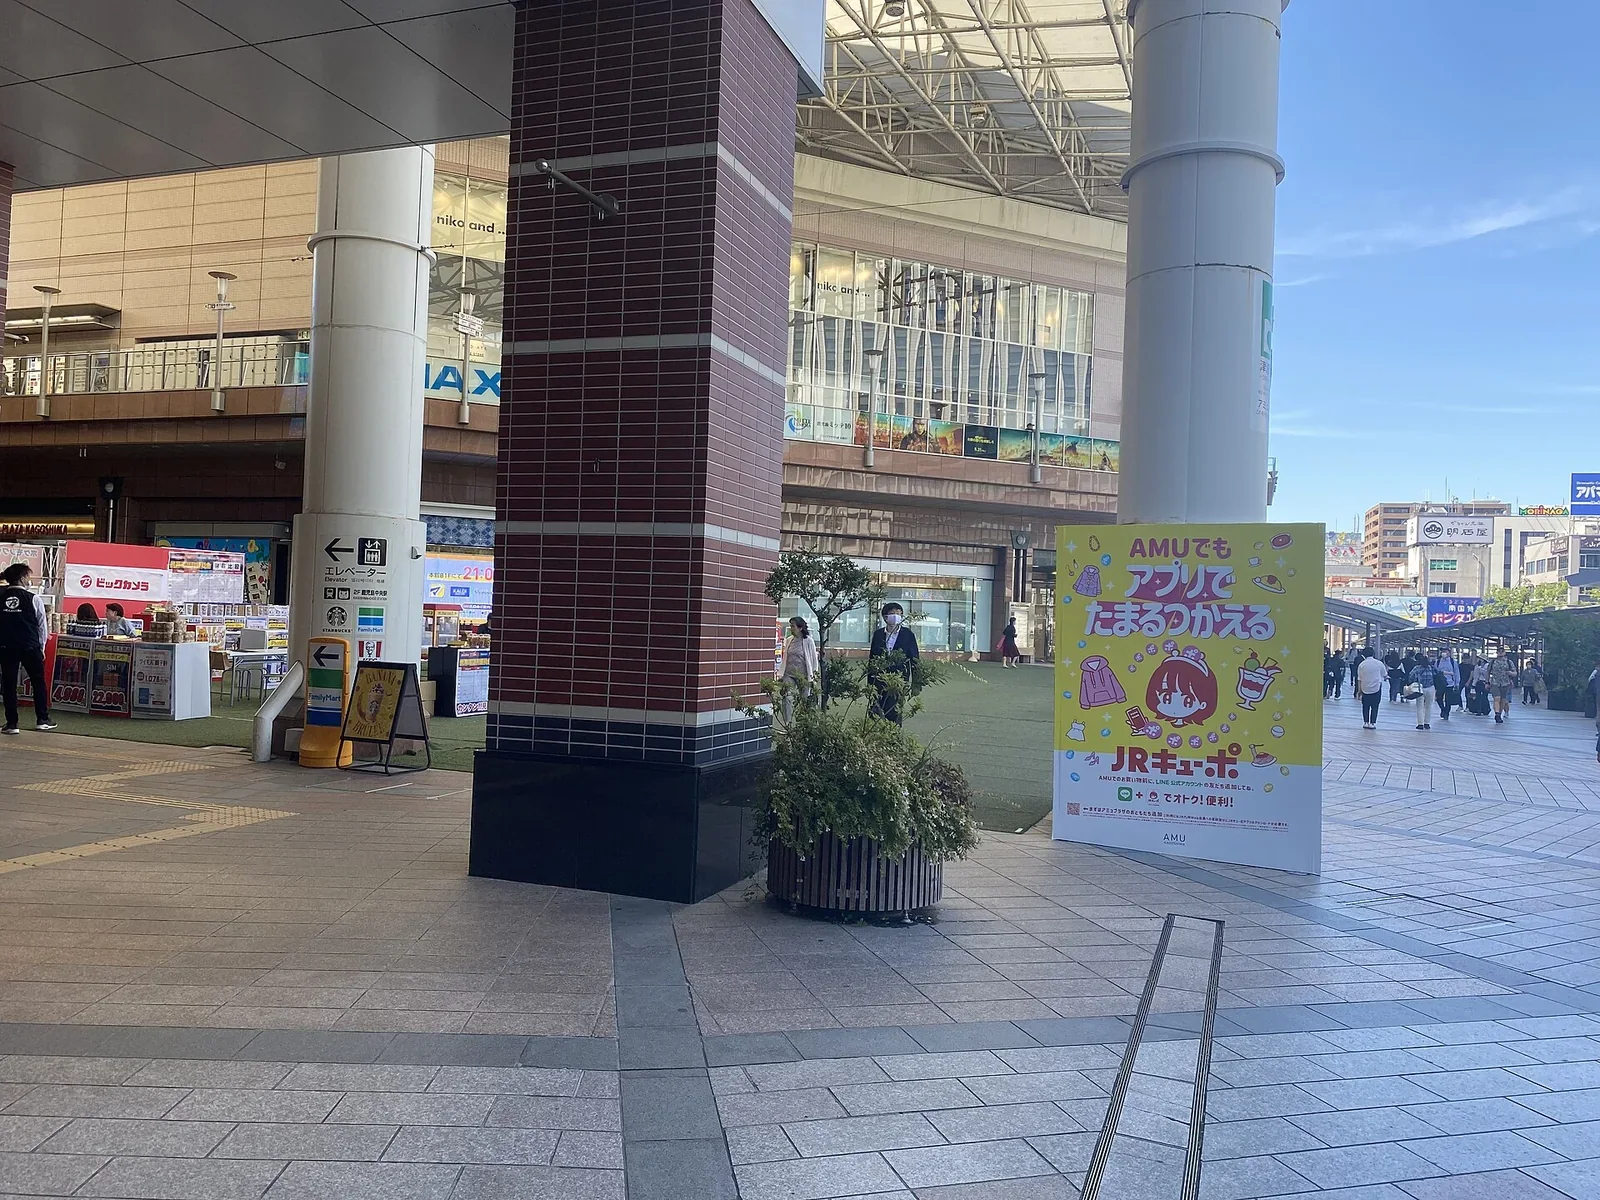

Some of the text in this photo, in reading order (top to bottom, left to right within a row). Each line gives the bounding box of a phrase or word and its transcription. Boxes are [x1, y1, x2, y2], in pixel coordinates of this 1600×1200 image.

[436, 214, 465, 228] niko
[468, 220, 495, 233] and
[1519, 505, 1569, 516] MORINAGA
[25, 524, 67, 535] KAGOSHIMA
[1446, 527, 1488, 538] 明石屋
[1129, 537, 1232, 559] AMUでも
[325, 566, 387, 578] エレベーター
[1124, 558, 1237, 599] アプリで
[96, 577, 149, 591] ビックカメラ
[1084, 600, 1276, 640] たまるつかえる
[308, 692, 341, 702] FamilyMart
[1111, 743, 1242, 779] JRキューポ
[1163, 833, 1186, 842] AMU
